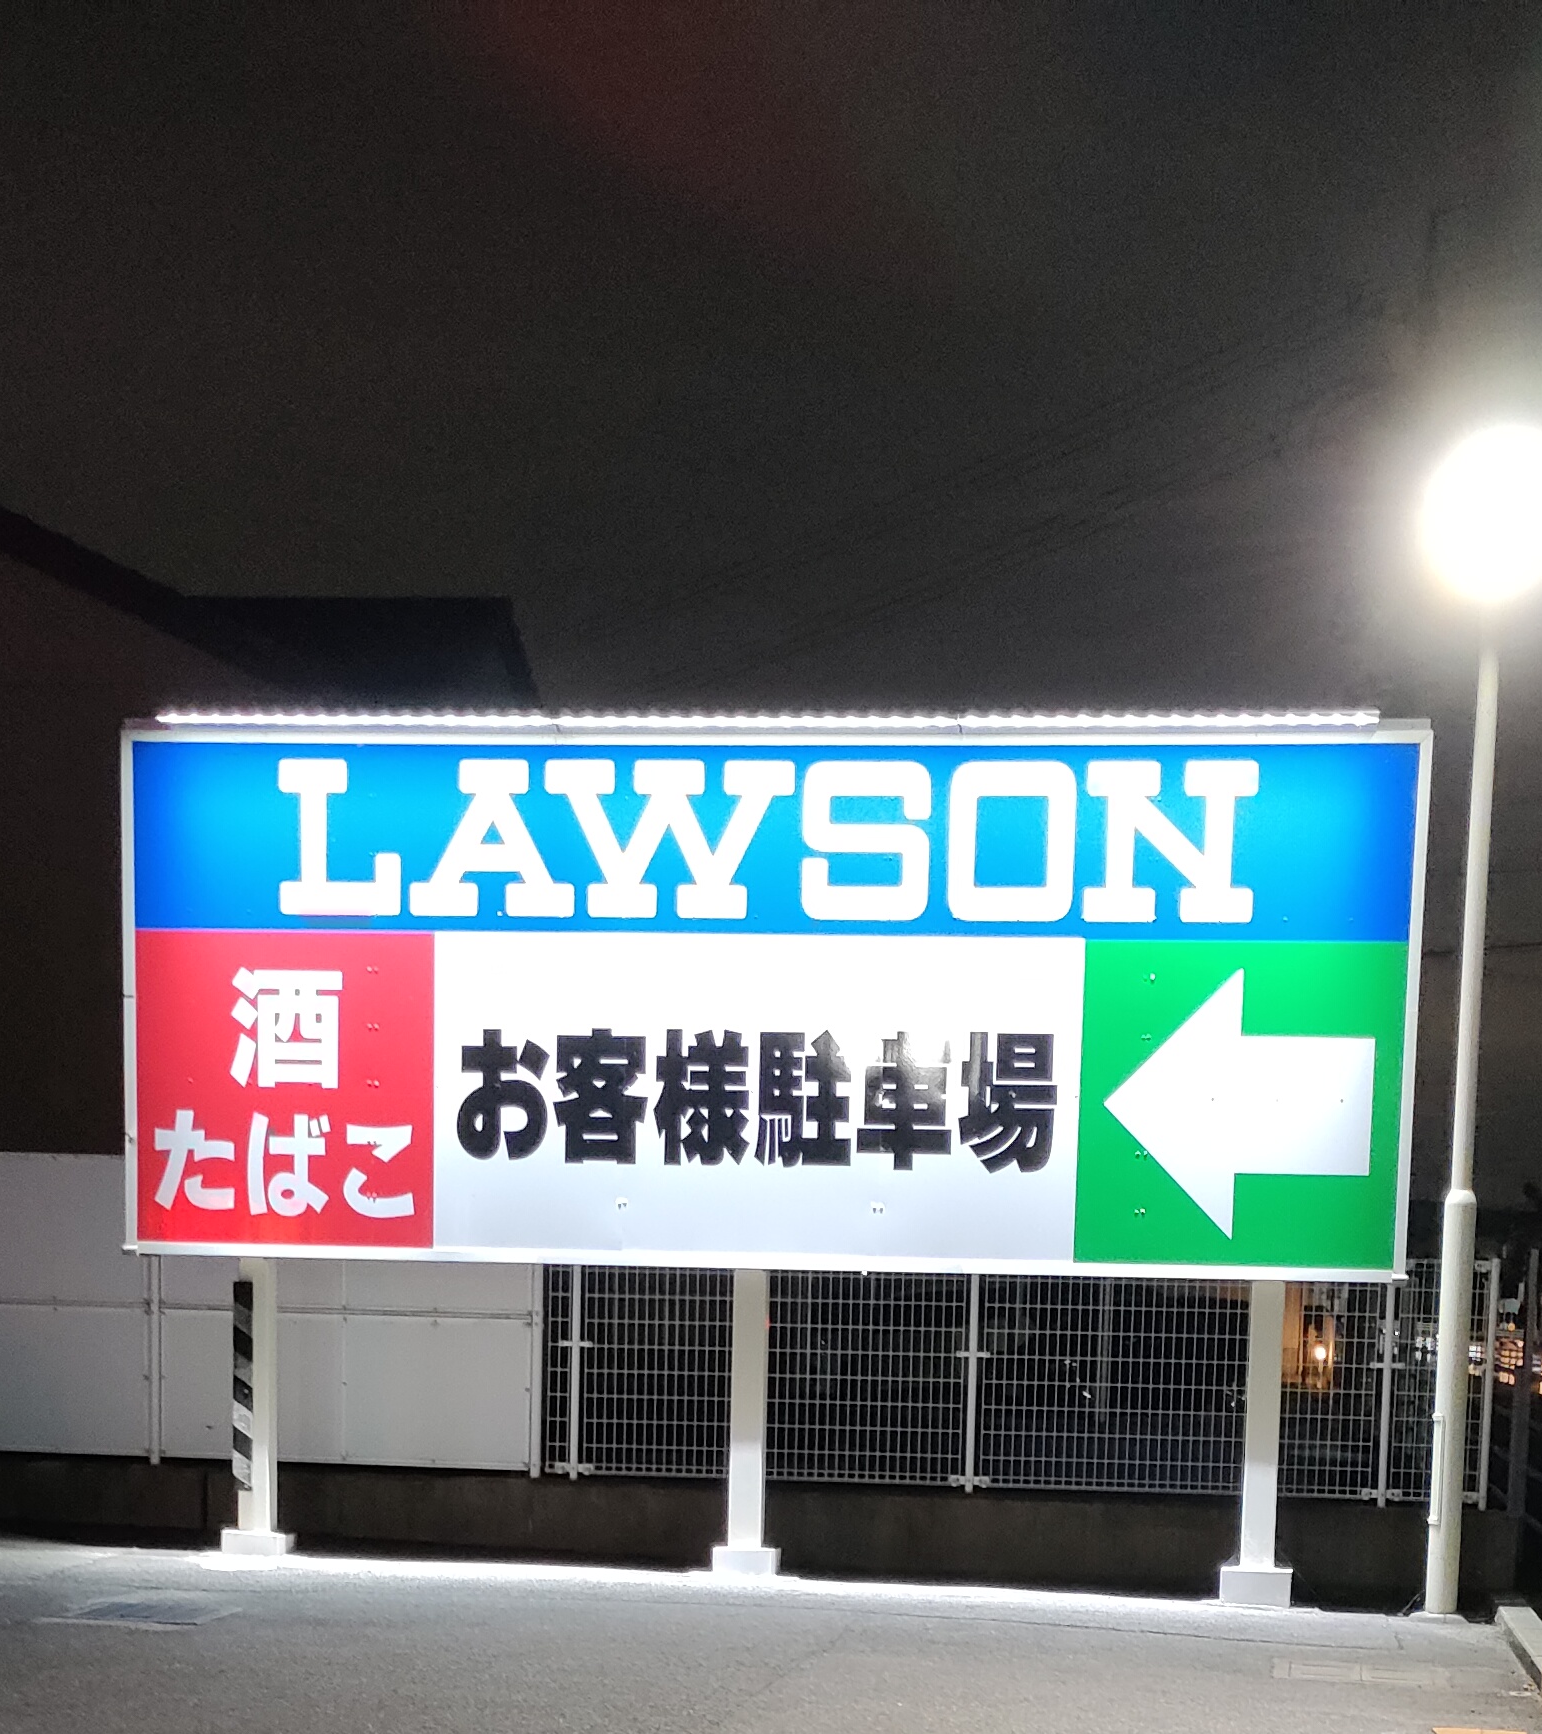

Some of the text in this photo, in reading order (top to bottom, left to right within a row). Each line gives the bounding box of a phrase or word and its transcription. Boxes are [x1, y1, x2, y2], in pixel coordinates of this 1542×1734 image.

[277, 757, 1262, 925] LAWSON
[228, 966, 345, 1090] 酒
[151, 1108, 416, 1220] たばこ
[454, 1027, 1059, 1173] お客様駐車場
